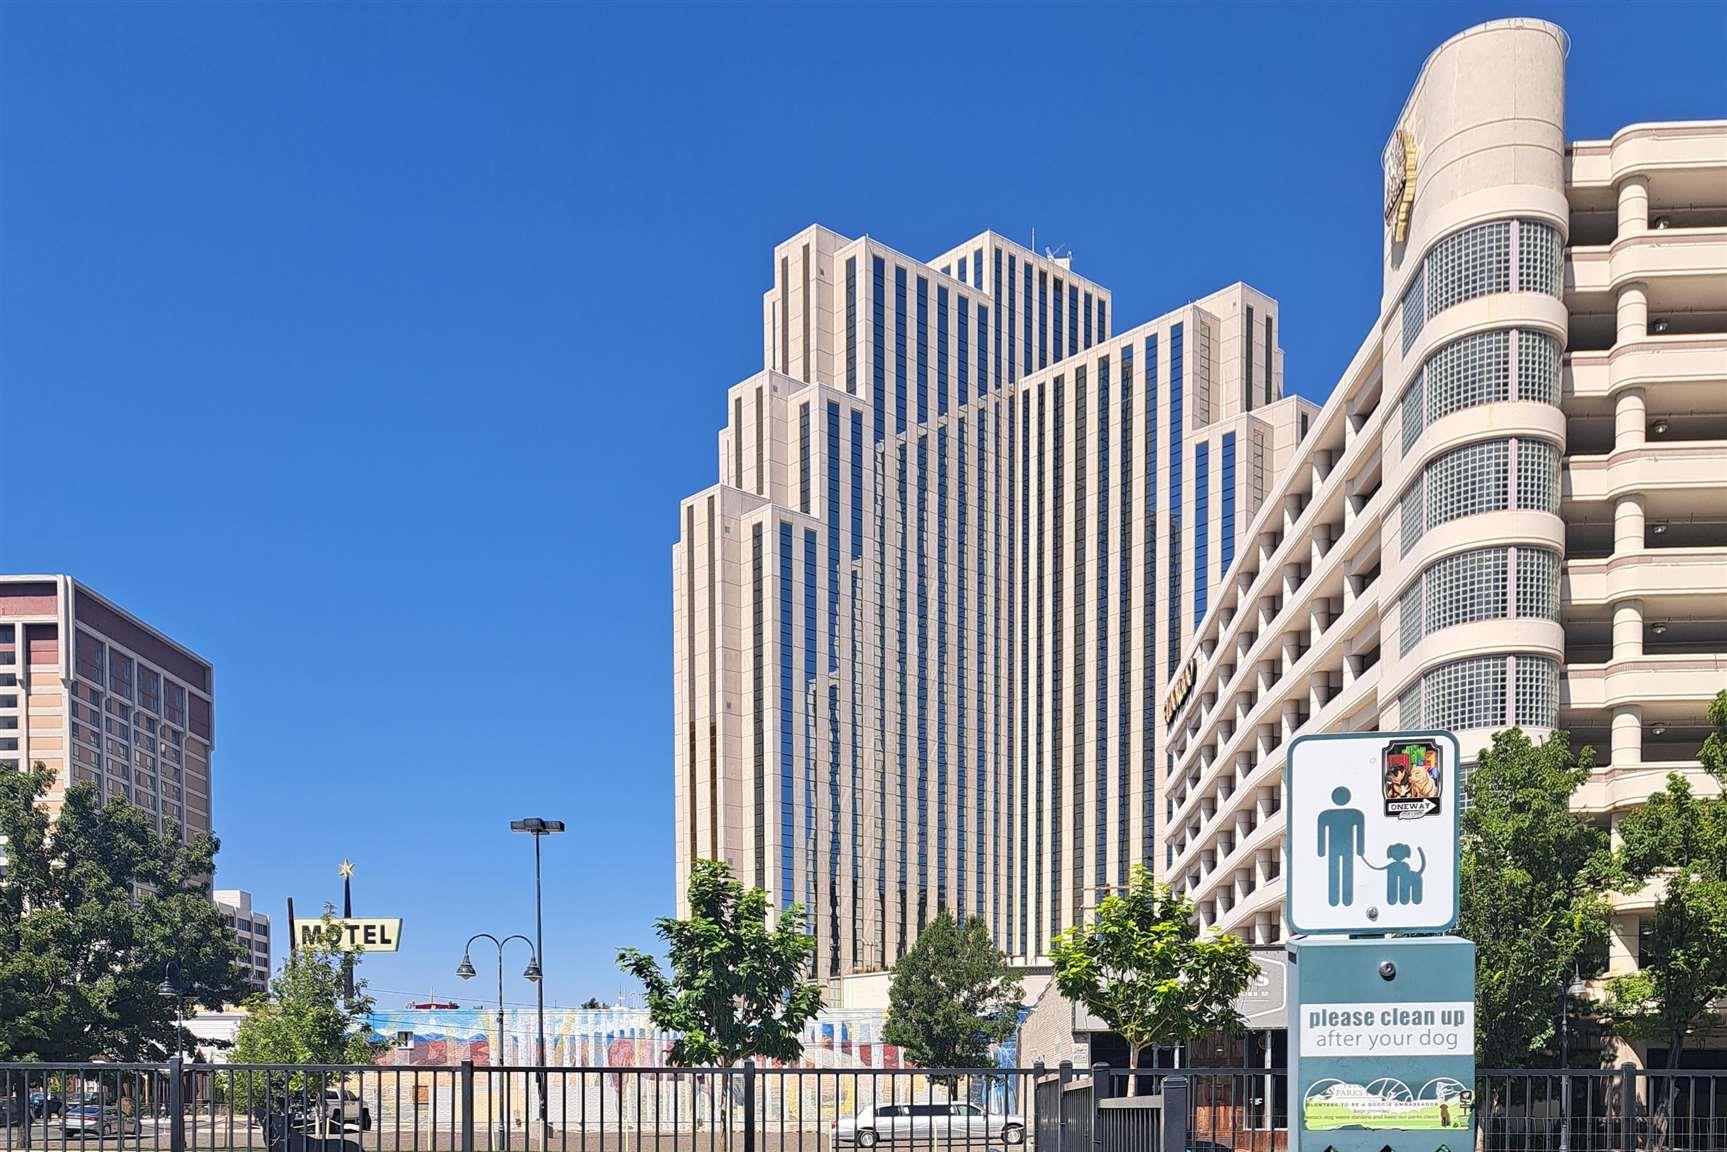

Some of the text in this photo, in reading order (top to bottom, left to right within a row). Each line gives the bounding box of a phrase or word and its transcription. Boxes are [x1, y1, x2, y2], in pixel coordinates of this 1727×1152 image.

[301, 924, 392, 945] MOTEL
[1309, 1008, 1465, 1029] please clean up
[1316, 1029, 1458, 1051] after your dog
